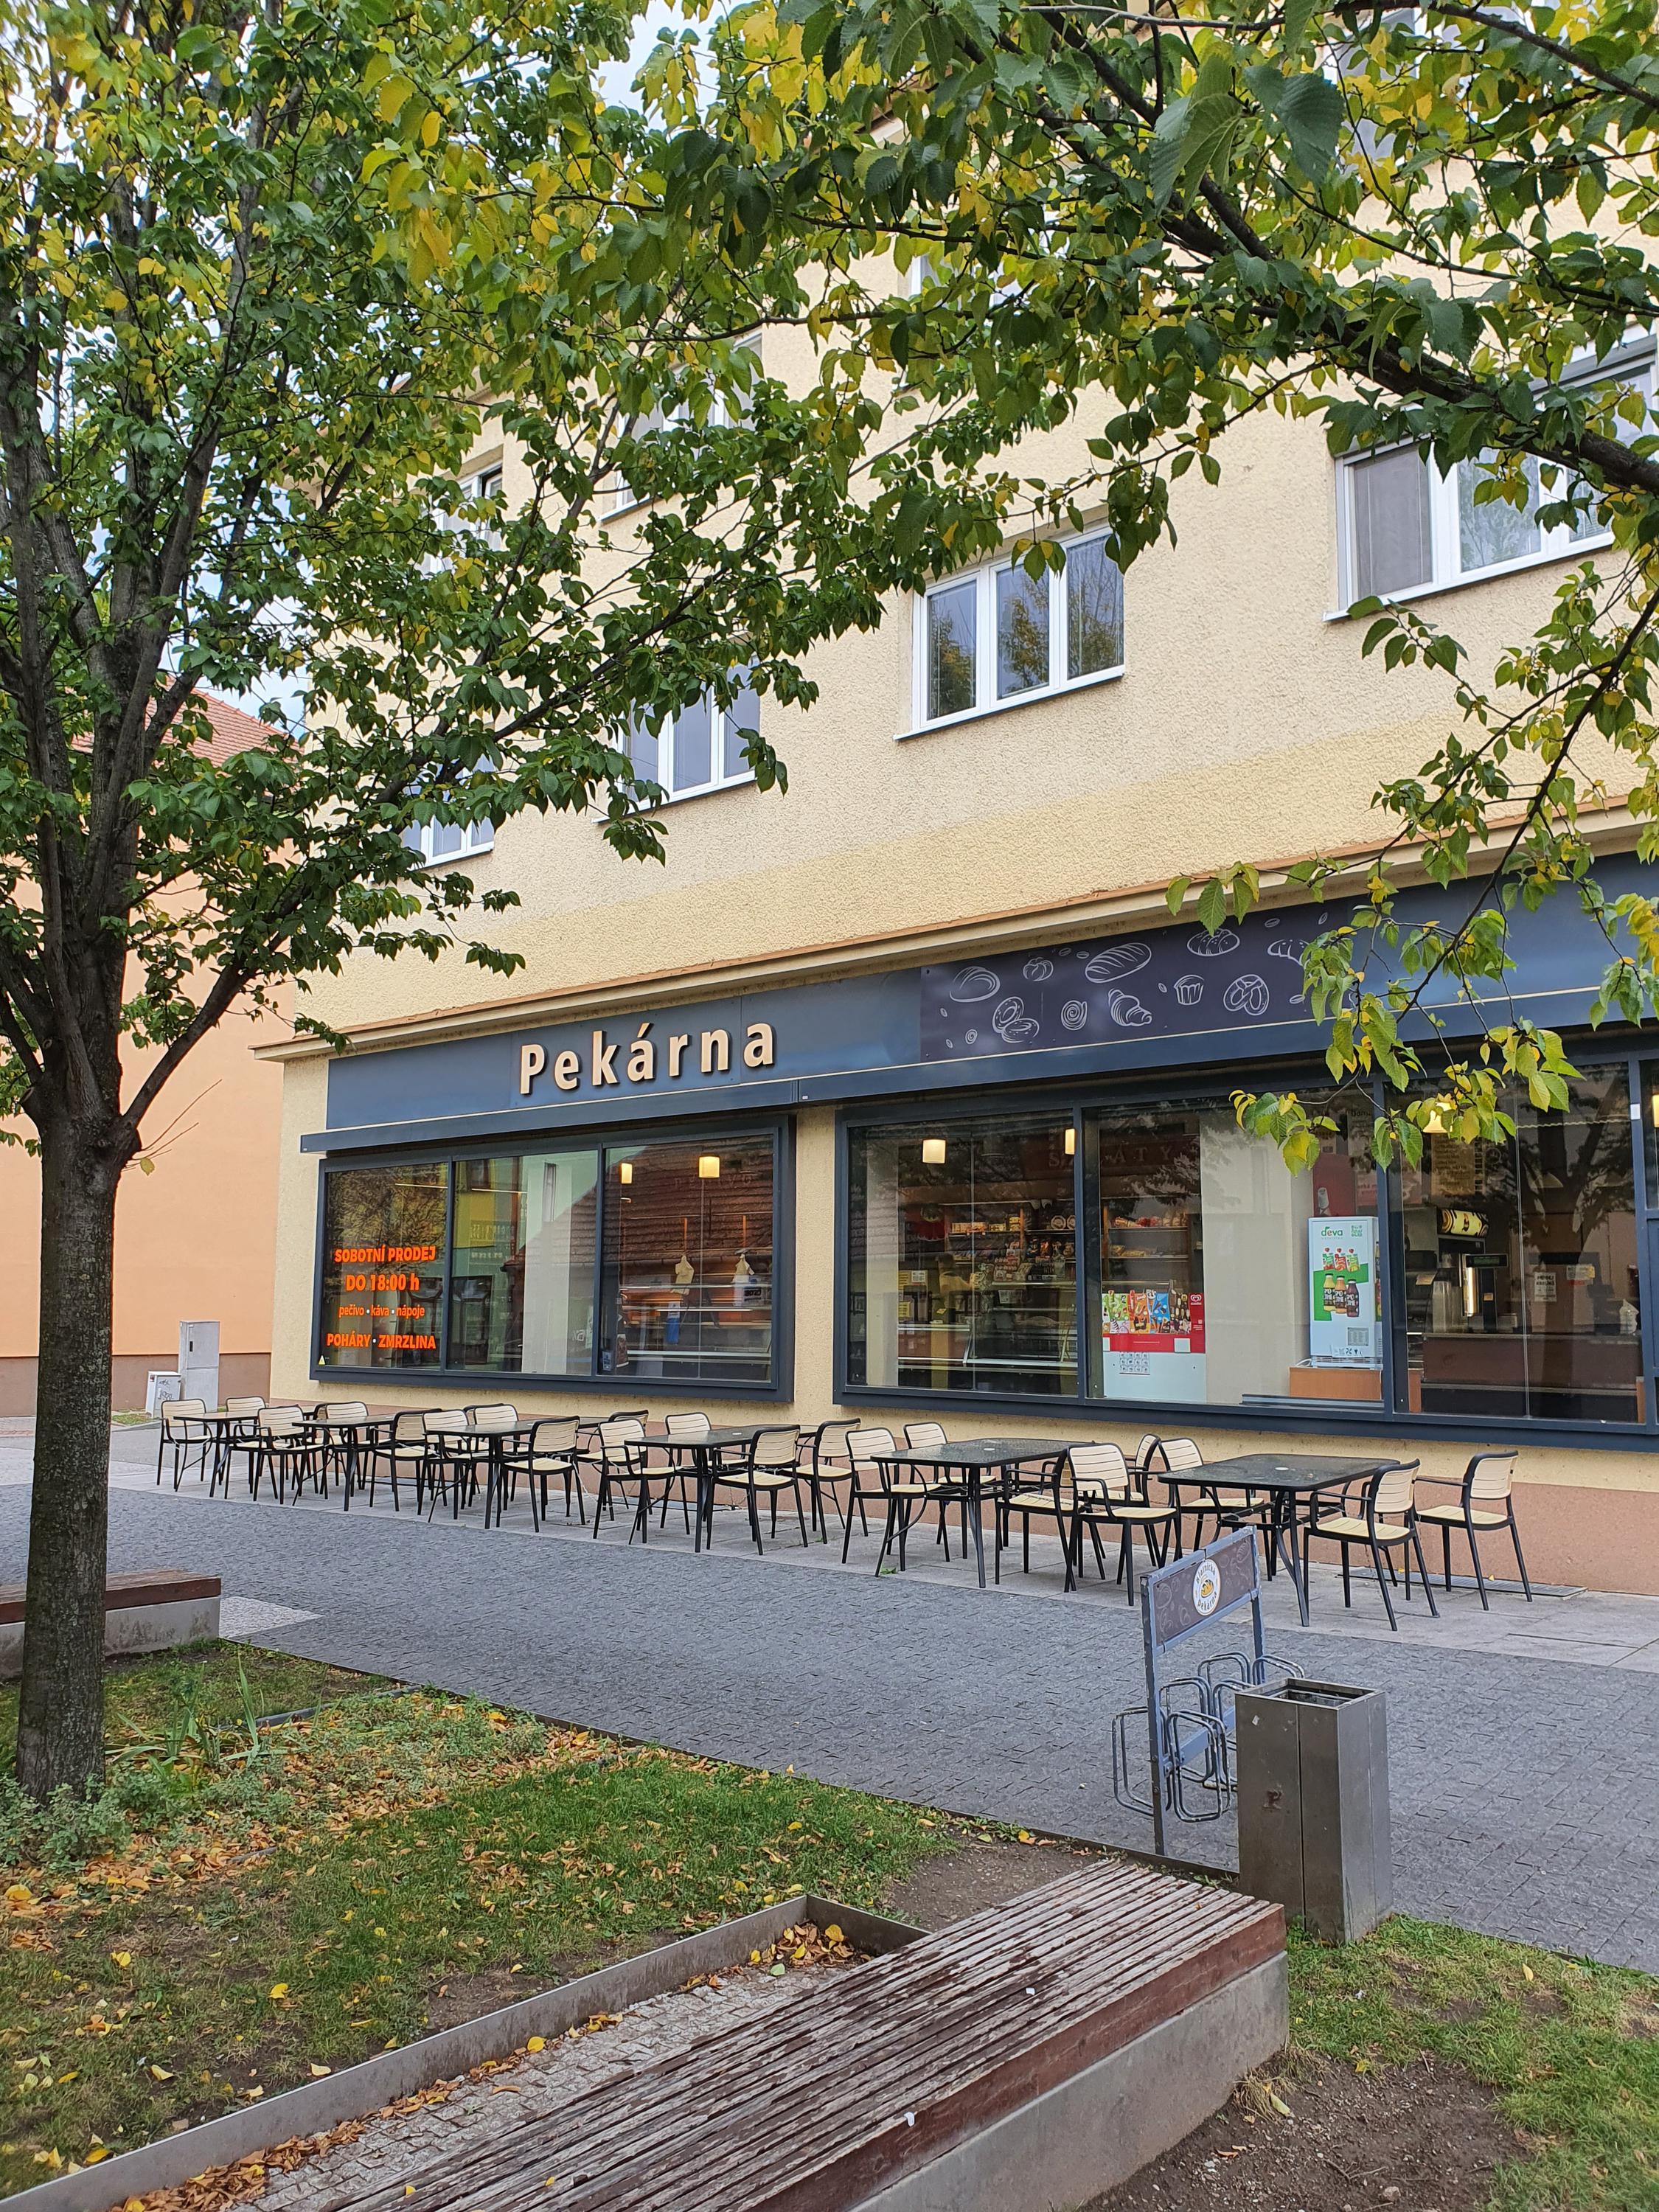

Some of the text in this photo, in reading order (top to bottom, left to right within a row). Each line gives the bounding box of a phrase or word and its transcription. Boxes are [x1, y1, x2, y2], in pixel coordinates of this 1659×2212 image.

[520, 1023, 774, 1094] Pekárna
[1321, 1226, 1343, 1237] deva
[334, 1244, 436, 1262] SOBOTNÍ PRODEJ
[345, 1273, 420, 1291] DO 18:00 h
[338, 1304, 425, 1319] pečivo káva nápoje
[327, 1330, 436, 1349] POHÁRY ZMRZLINA
